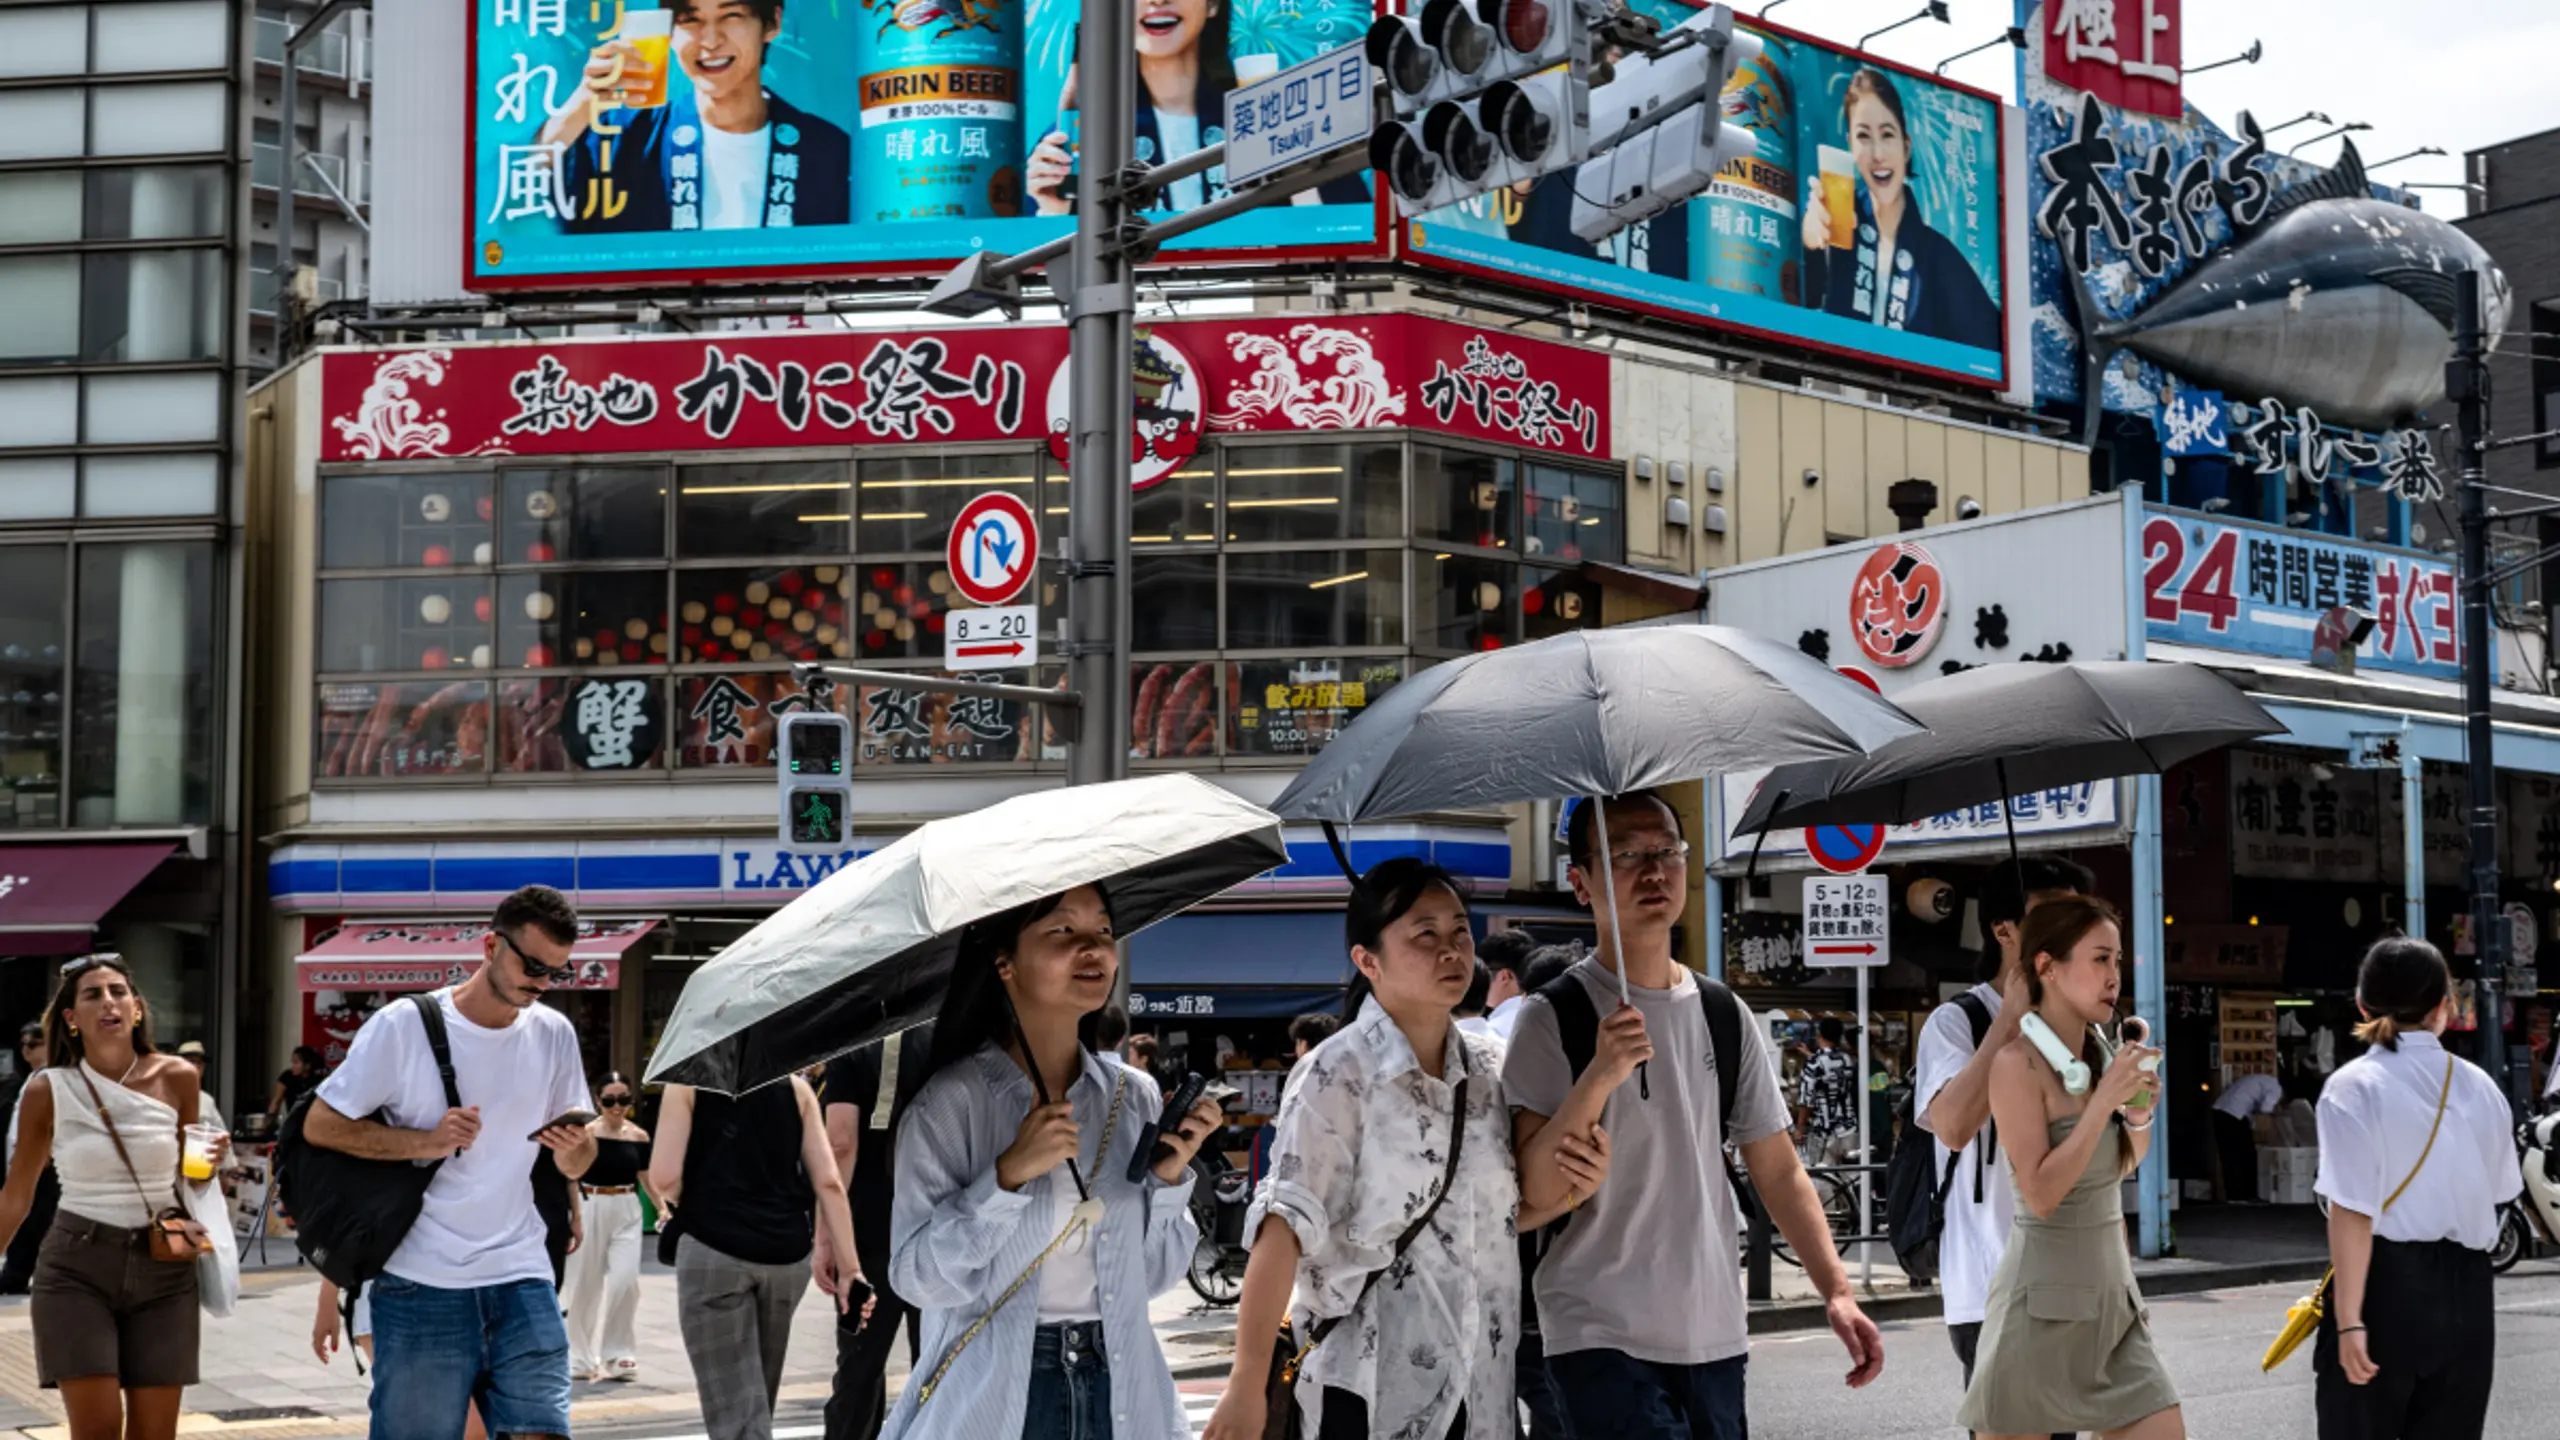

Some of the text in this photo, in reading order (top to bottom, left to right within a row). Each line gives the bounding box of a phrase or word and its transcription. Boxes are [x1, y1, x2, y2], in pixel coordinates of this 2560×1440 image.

[2053, 0, 2179, 85] 極上
[869, 70, 1007, 101] KIRIN BEER
[1233, 55, 1361, 143] 築地四丁目
[886, 127, 990, 161] 晴れ風
[1267, 113, 1332, 156] Tsukiji 4
[1710, 204, 1780, 249] 晴れ風
[1461, 334, 1526, 381] 築地
[503, 337, 1026, 440] 築地 かに祭り
[1420, 359, 1597, 453] かに祭り
[2163, 397, 2226, 453] 築地
[2244, 397, 2444, 501] すし一番
[1265, 681, 1366, 709] 飲み放題
[575, 679, 650, 768] 蟹
[1268, 728, 1307, 743] 10:00
[1808, 919, 1884, 937] 貨物車を除く
[310, 971, 360, 985] CRABS
[364, 969, 442, 985] PARADISE
